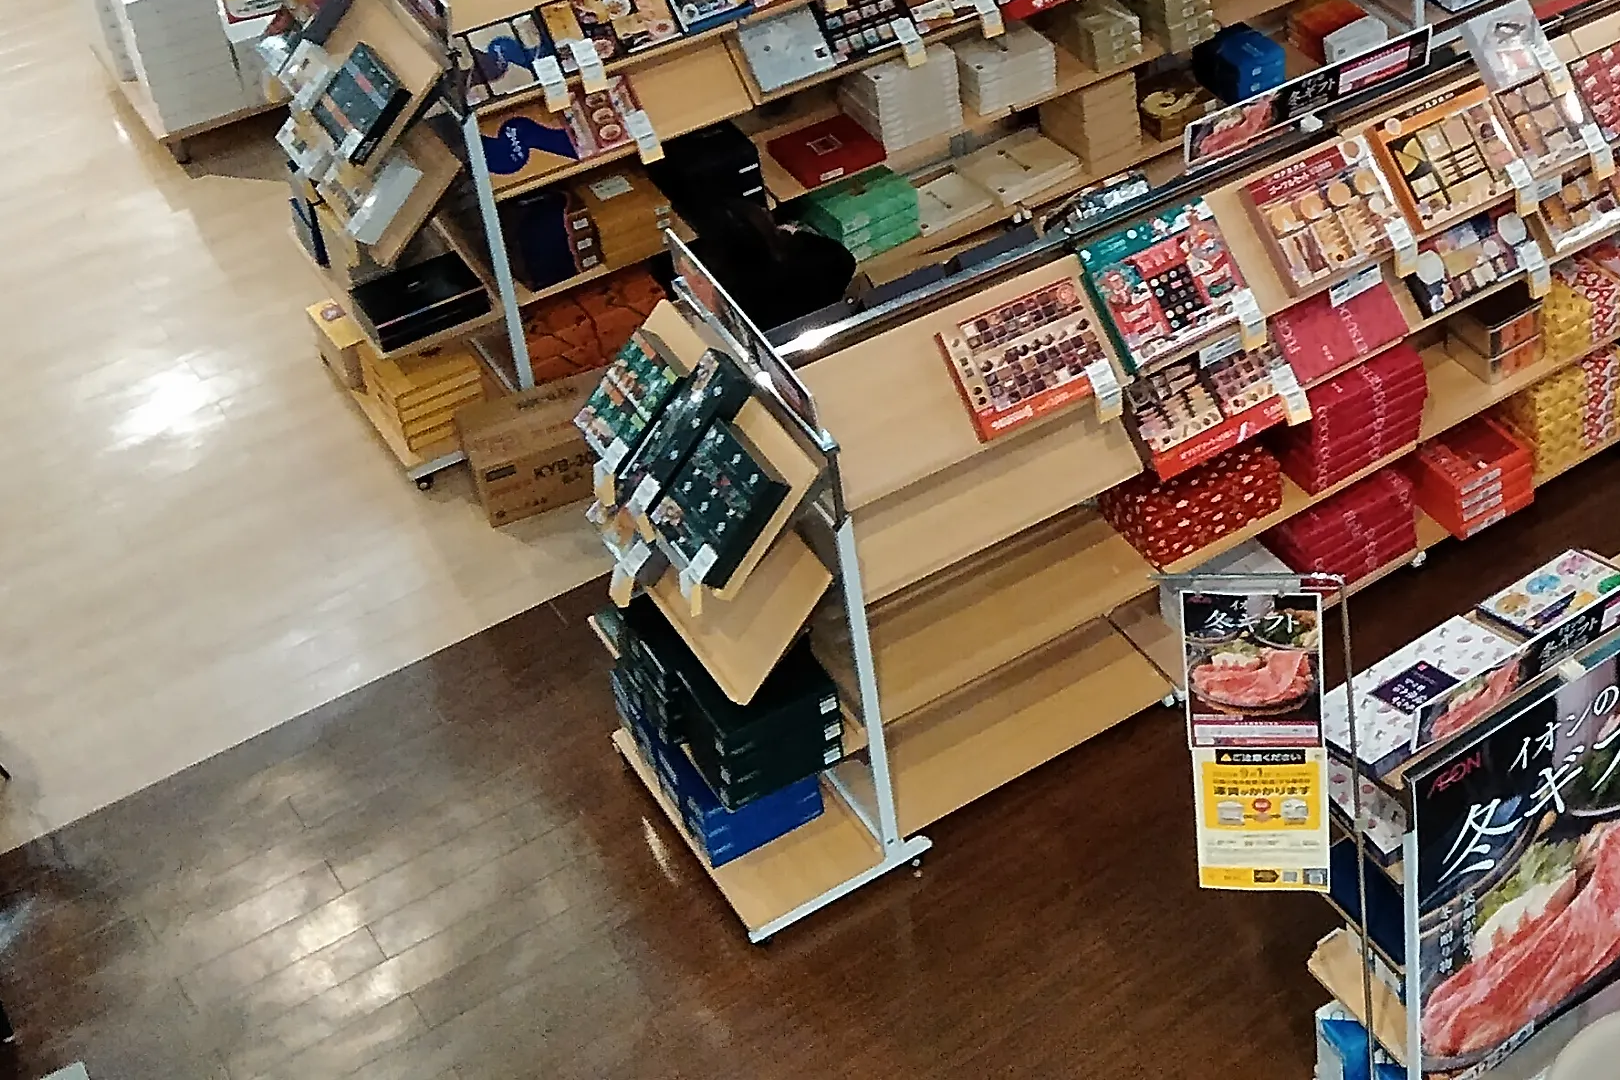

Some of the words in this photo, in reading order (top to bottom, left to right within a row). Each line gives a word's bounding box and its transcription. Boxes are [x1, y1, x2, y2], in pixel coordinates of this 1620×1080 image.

[1289, 78, 1336, 105] 冬ギフト
[1203, 609, 1300, 636] 冬ギフト
[1507, 685, 1620, 773] イオンの
